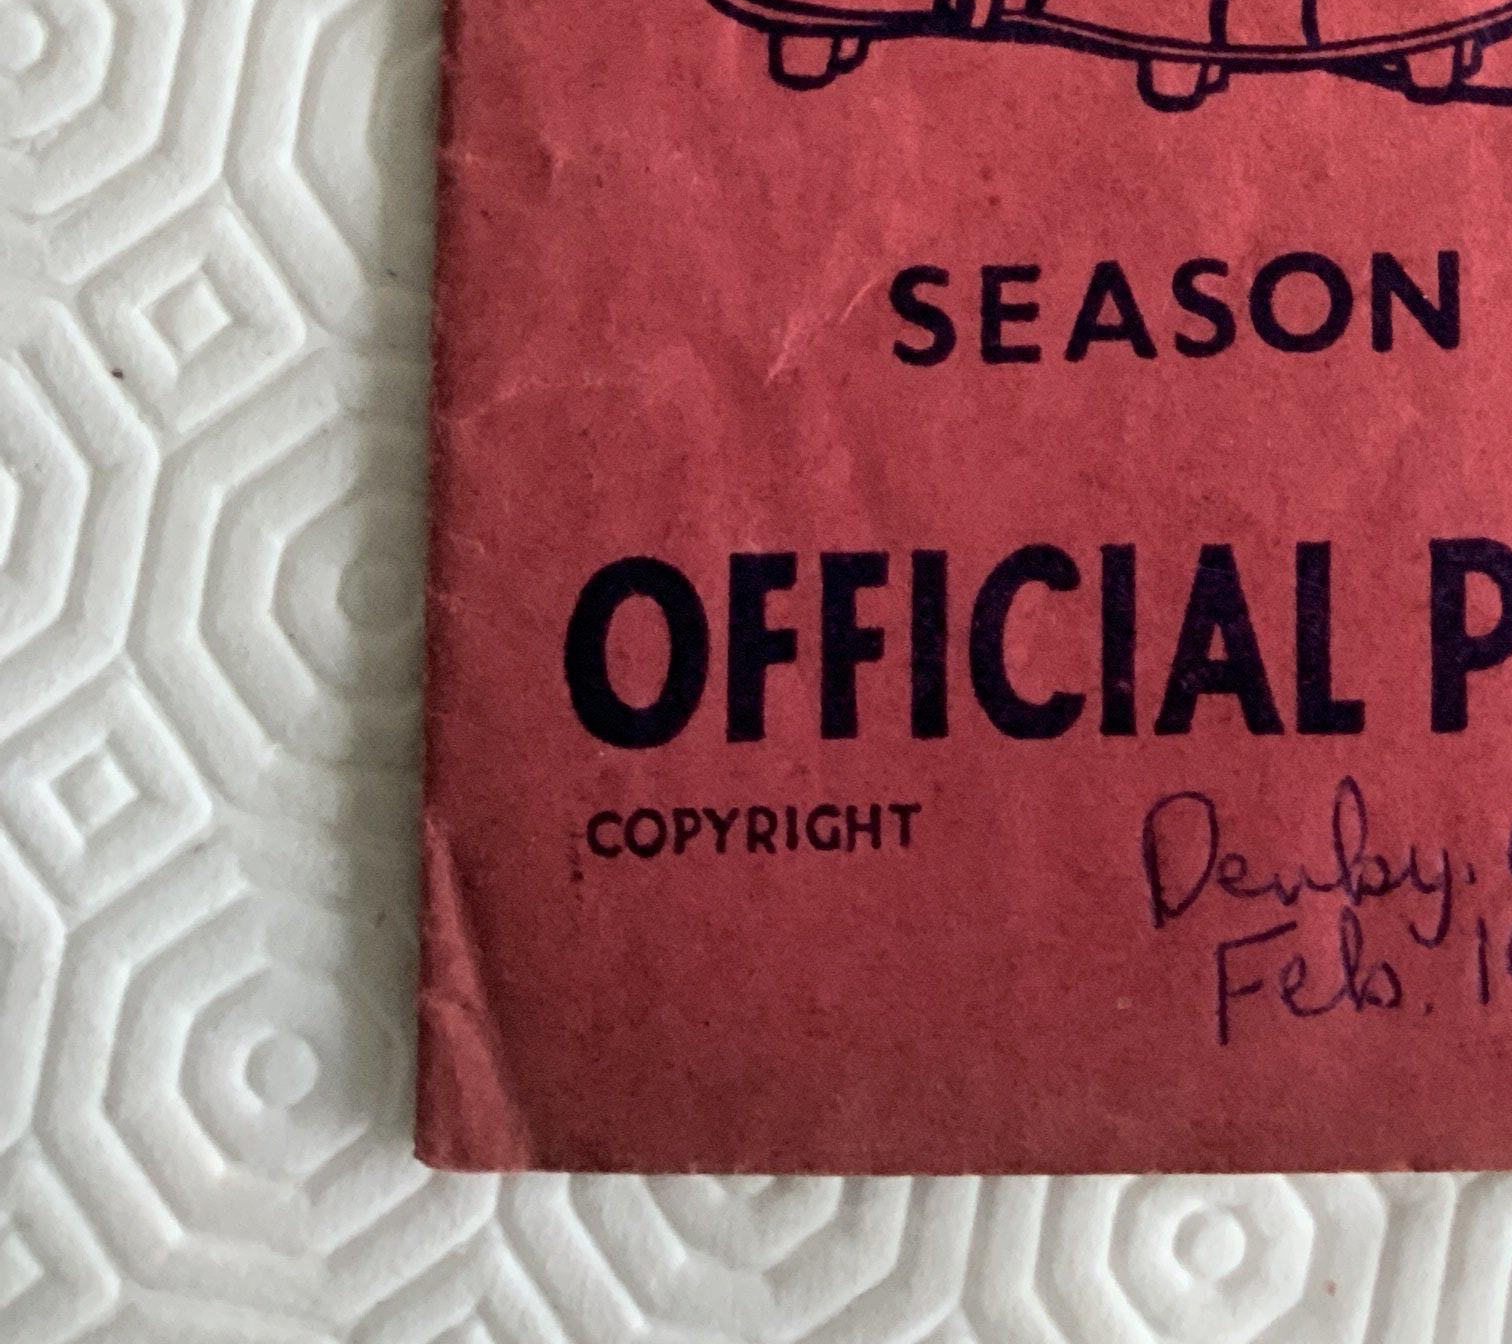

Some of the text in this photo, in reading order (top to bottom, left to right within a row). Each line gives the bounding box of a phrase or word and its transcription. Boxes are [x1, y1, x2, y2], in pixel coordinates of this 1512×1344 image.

[888, 250, 1462, 367] SEASON
[563, 542, 1366, 750] OFFICIAL
[585, 802, 922, 859] COPYRIGHT
